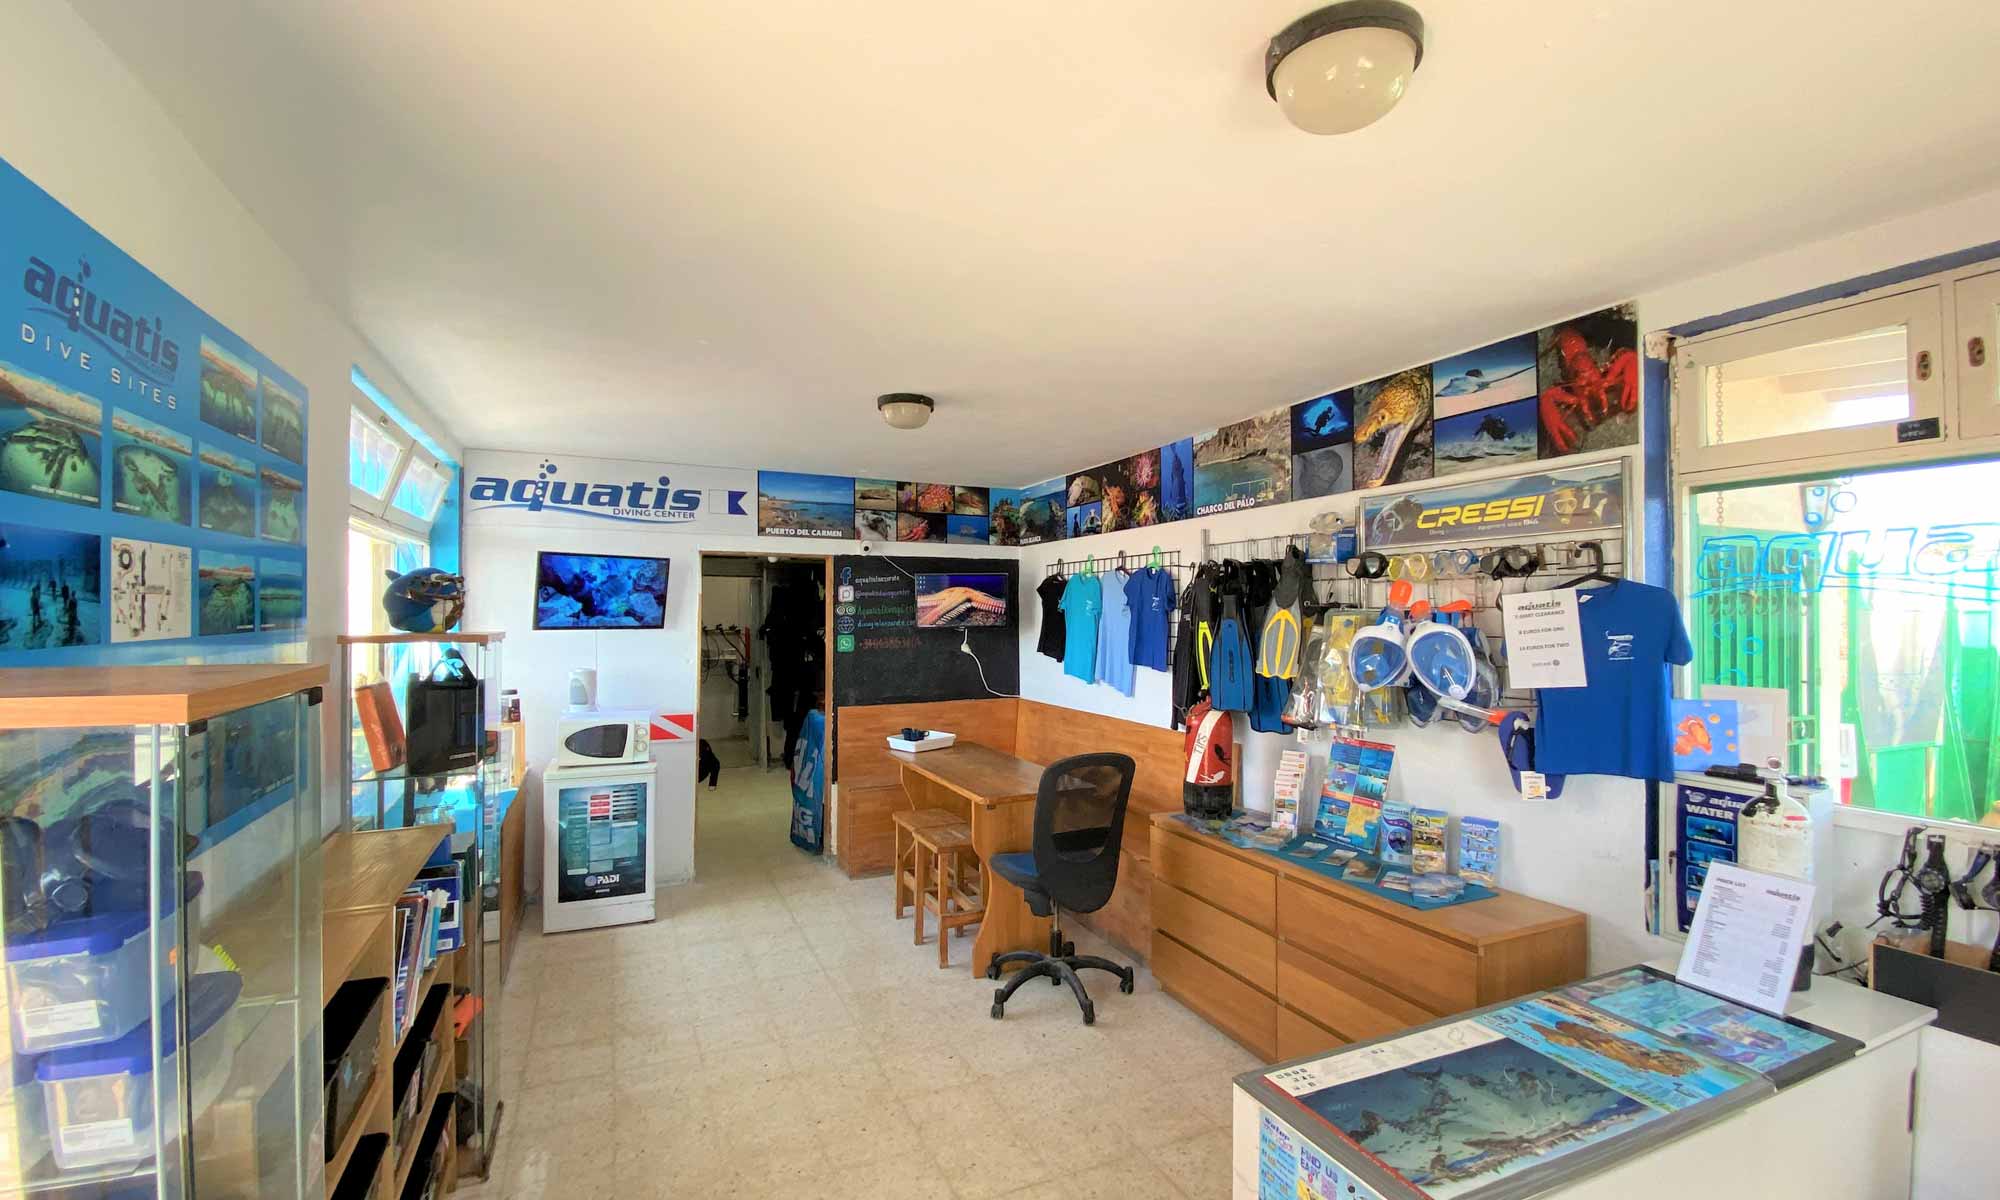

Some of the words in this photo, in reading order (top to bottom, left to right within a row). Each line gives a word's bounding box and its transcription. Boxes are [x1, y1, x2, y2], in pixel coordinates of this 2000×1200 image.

[24, 256, 180, 373] aquatis
[21, 322, 92, 370] DIVE
[111, 368, 177, 410] SITES
[469, 475, 702, 512] aquatis
[612, 507, 652, 518] DIVING
[653, 509, 696, 520] CENTER
[1196, 503, 1223, 515] CHARCO
[1224, 501, 1236, 511] DEL
[1237, 497, 1255, 509] PALO
[1416, 495, 1546, 529] CRESSI
[765, 527, 794, 537] PUERTO
[795, 528, 809, 537] DEL
[811, 529, 842, 538] CARMEN
[1517, 600, 1561, 611] aquatis
[1535, 610, 1566, 618] CLEARANCE
[1194, 732, 1207, 754] TIPS
[1686, 804, 1734, 820] WATER
[597, 873, 620, 885] PADI
[1300, 1146, 1321, 1170] FIND
